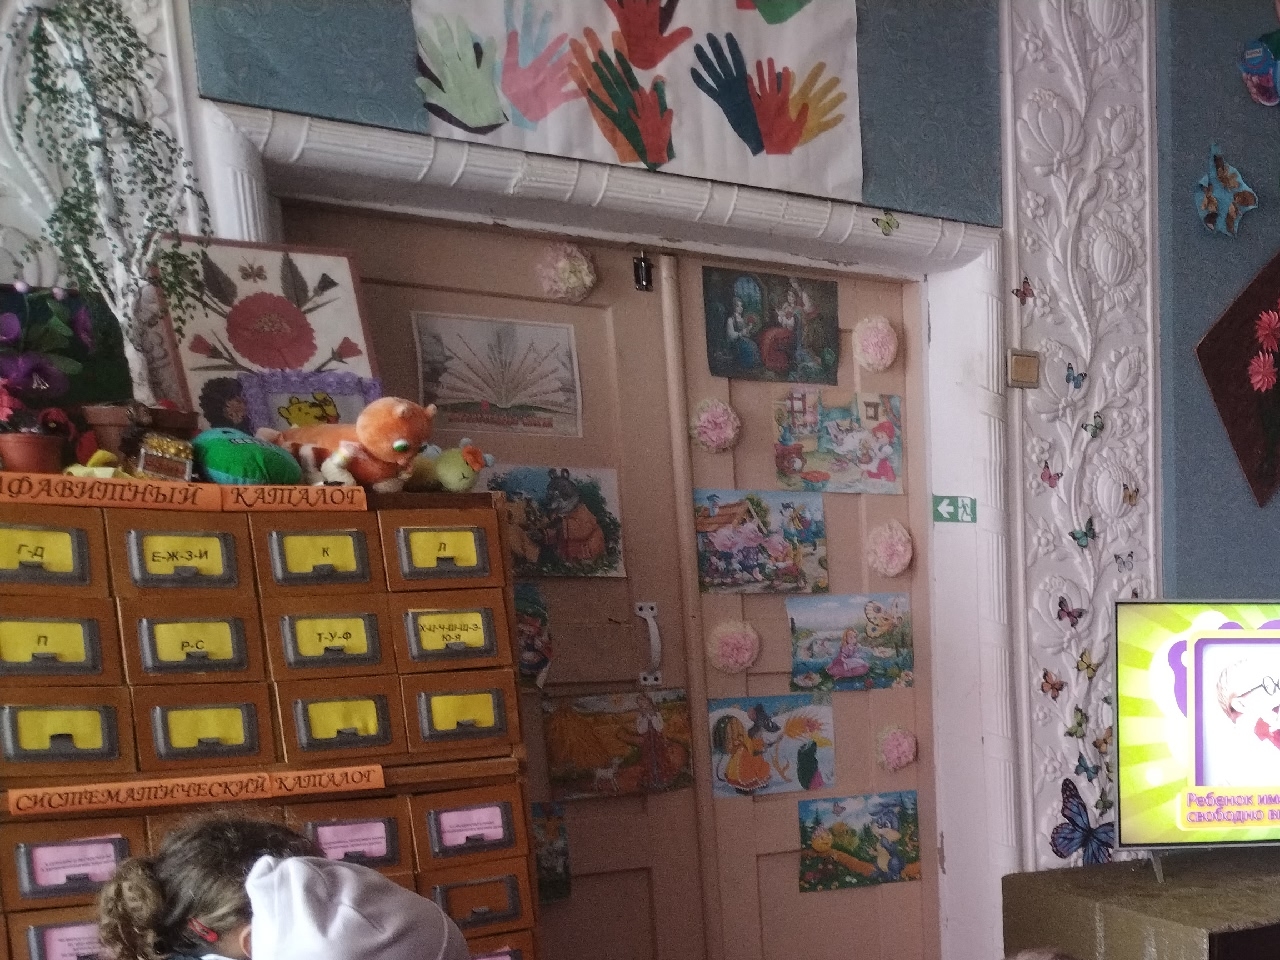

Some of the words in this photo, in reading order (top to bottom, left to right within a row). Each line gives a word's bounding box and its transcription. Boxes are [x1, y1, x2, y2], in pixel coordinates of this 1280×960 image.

[231, 486, 362, 508] КАТАЛОГ
[152, 550, 209, 563] Е-Ж-З-И
[321, 546, 330, 558] К
[37, 635, 48, 646] П
[317, 632, 352, 643] Т-У-Ф
[15, 774, 269, 812] СИСТЕМАТИЧЕСКИЙ
[273, 768, 377, 792] КАТАЛОГ
[1187, 791, 1253, 807] Ребенок
[1187, 806, 1264, 823] свободно
